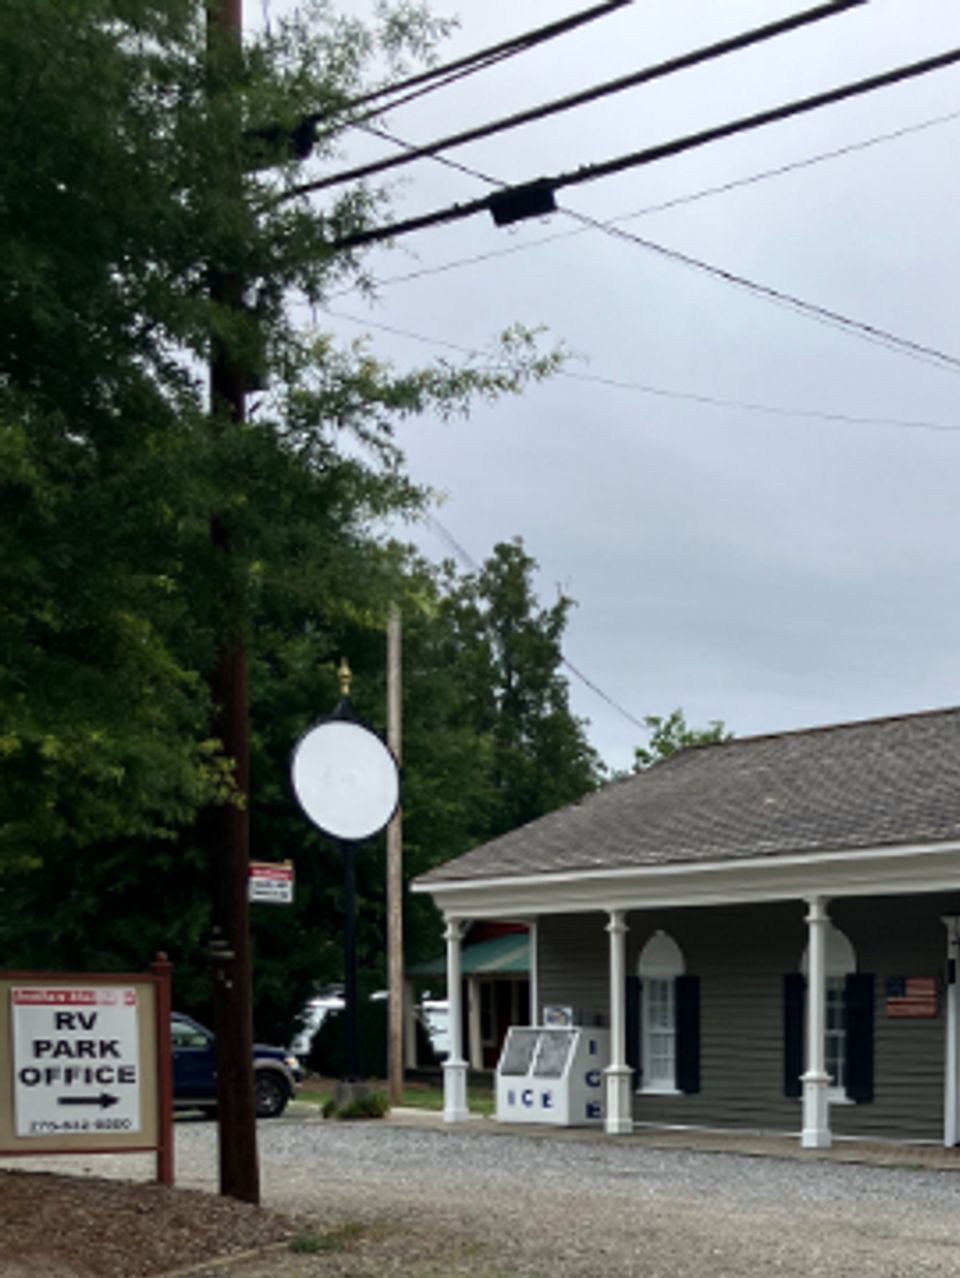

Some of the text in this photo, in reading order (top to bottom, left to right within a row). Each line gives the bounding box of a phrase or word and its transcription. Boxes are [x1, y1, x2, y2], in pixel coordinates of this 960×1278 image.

[55, 1011, 98, 1031] RV
[32, 1039, 121, 1059] PARK
[18, 1065, 136, 1087] OFFICE
[507, 1089, 553, 1108] ICE
